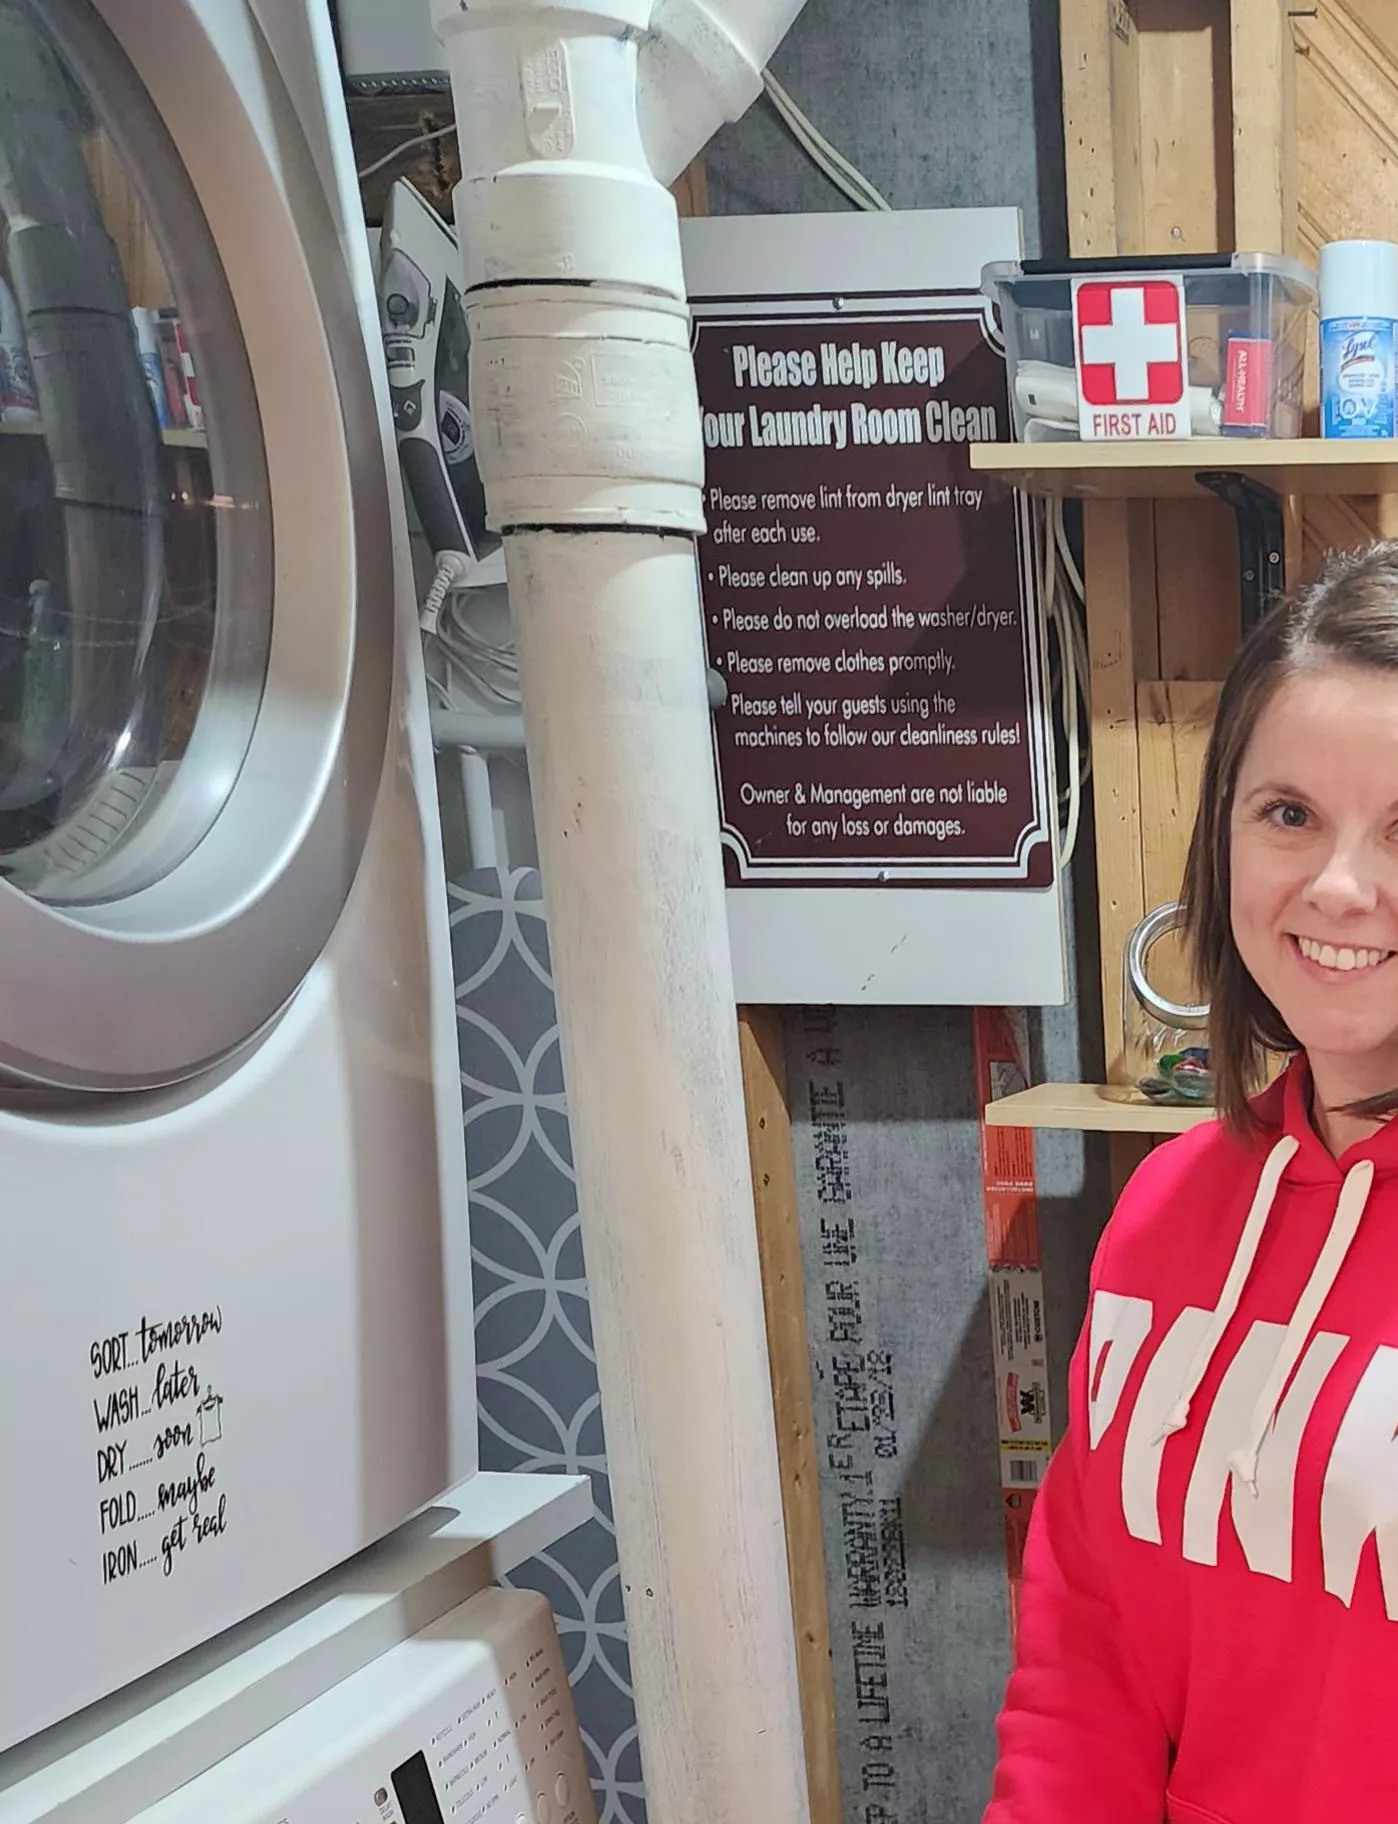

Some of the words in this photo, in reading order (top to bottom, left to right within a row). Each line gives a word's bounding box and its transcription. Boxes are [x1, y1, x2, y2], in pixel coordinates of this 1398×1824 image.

[732, 344, 817, 389] Please
[820, 341, 878, 389] Help
[881, 340, 946, 388] Keep
[701, 407, 745, 448] our
[748, 402, 847, 450] Laundry
[850, 402, 922, 445] Room
[925, 400, 997, 443] Clean
[1092, 413, 1141, 438] FIRST
[1147, 412, 1177, 437] AID
[710, 487, 757, 512] Please
[761, 488, 816, 510] remove
[819, 486, 843, 509] lint
[846, 485, 882, 509] from
[885, 484, 924, 514] dryer
[927, 484, 951, 508] lint
[954, 485, 984, 511] tray
[713, 521, 748, 545] after
[751, 520, 787, 543] each
[790, 523, 821, 544] use.
[718, 565, 765, 589] Please
[769, 564, 809, 587] clean
[812, 567, 832, 590] up
[836, 568, 863, 591] any
[866, 561, 907, 591] spills.
[722, 607, 770, 632] Please
[773, 606, 793, 630] do
[797, 606, 820, 630] not
[824, 604, 888, 629] overload
[891, 603, 915, 628] the
[918, 603, 1018, 631] washer/dryer.
[727, 650, 773, 674] Please
[777, 652, 831, 674] remove
[834, 648, 885, 673] clothes
[888, 647, 956, 675] promptly.
[731, 692, 778, 717] Please
[780, 692, 802, 715] tell
[806, 695, 838, 720] your
[842, 694, 887, 720] guests
[890, 693, 929, 720] using
[932, 692, 956, 714] the
[734, 723, 803, 748] machines
[806, 726, 821, 747] to
[823, 722, 868, 747] follow
[870, 726, 896, 746] our
[899, 722, 978, 746] cleanliness
[981, 721, 1021, 745] rules!
[740, 781, 791, 806] Owner
[794, 783, 807, 805] &
[810, 781, 907, 810] Management
[910, 785, 935, 805] are
[939, 782, 964, 804] not
[966, 780, 1008, 805] liable
[786, 813, 808, 837] for
[812, 816, 839, 841] any
[842, 813, 870, 837] loss
[873, 817, 889, 836] or
[894, 813, 966, 841] damages.
[134, 1304, 222, 1364] tomorrow
[151, 1359, 200, 1409] later
[153, 1422, 194, 1459] soon
[157, 1451, 216, 1516] maybe
[161, 1515, 189, 1577] get
[192, 1492, 228, 1544] real
[849, 1620, 891, 1725] LIFETIME
[858, 1736, 893, 1753] A
[861, 1761, 895, 1791] TO
